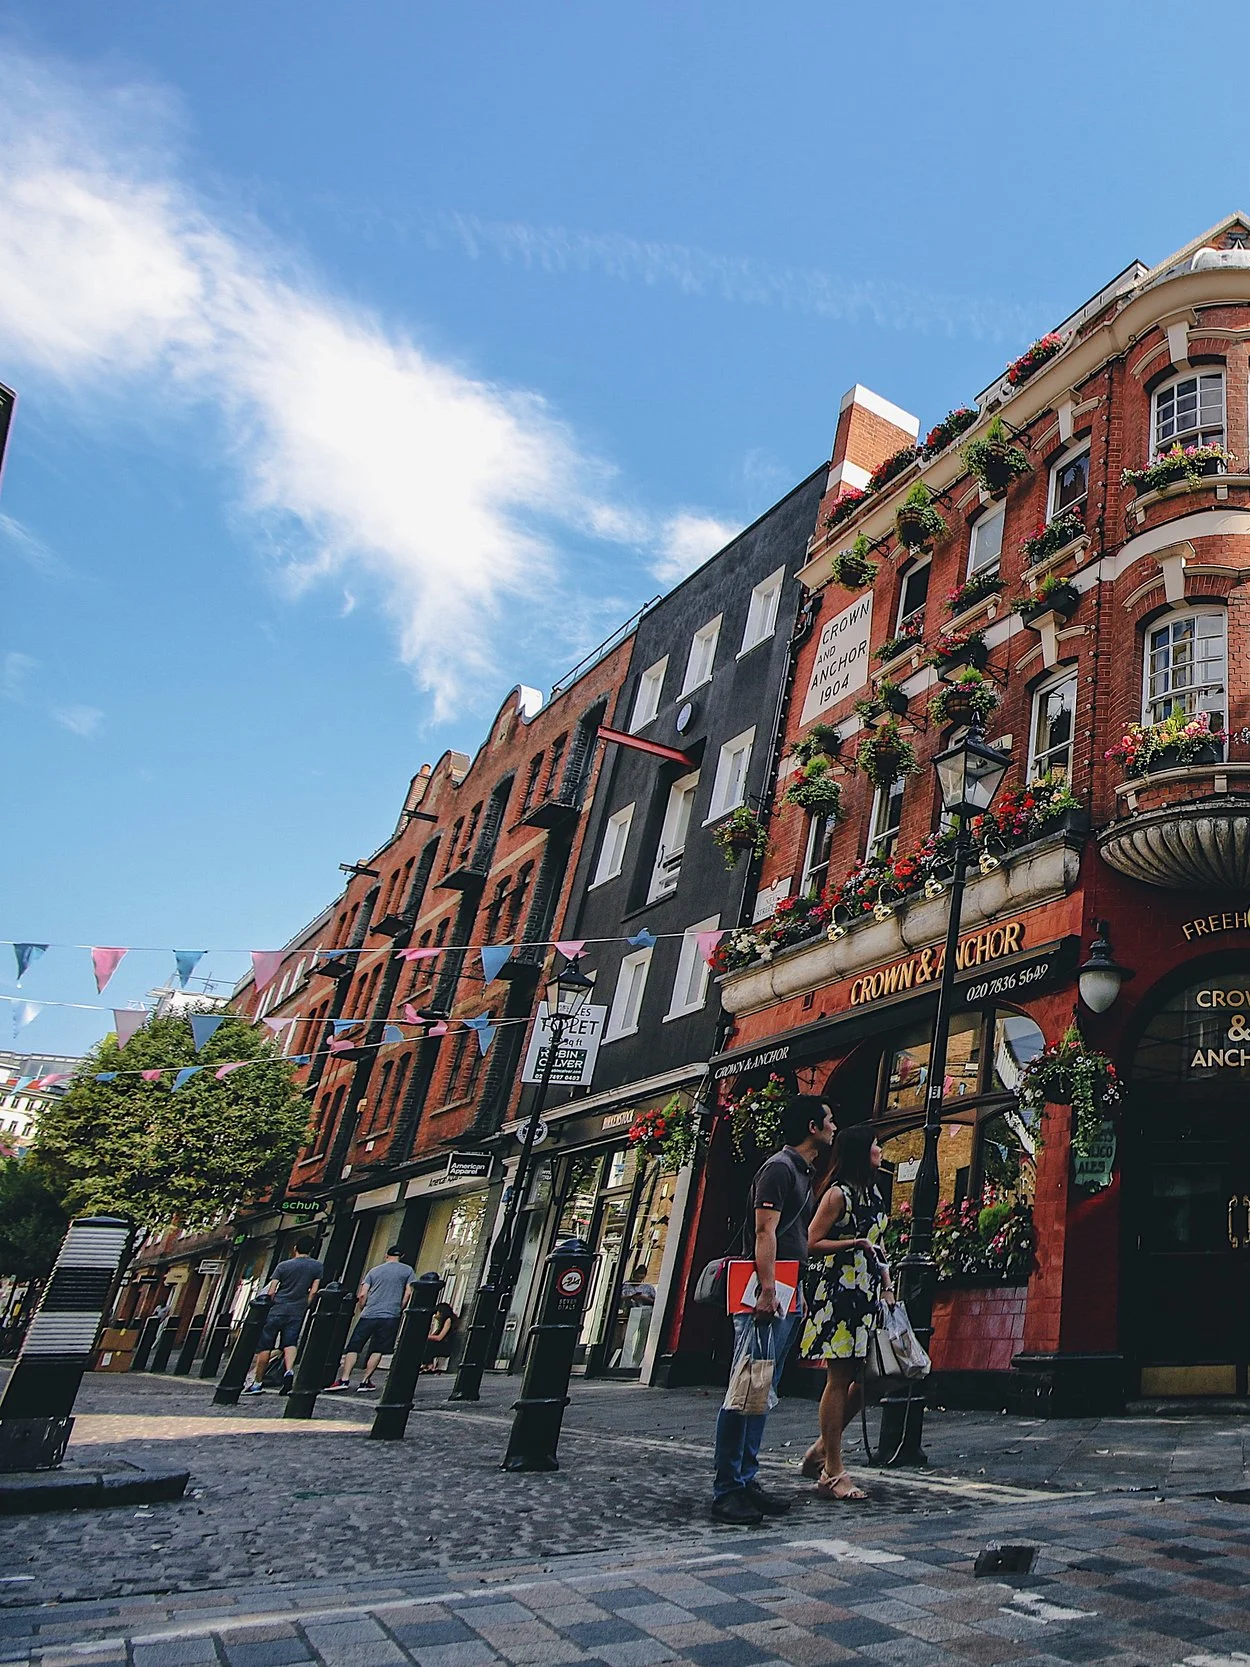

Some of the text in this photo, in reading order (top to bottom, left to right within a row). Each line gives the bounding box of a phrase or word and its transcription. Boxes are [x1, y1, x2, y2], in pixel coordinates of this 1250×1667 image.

[822, 600, 870, 645] CROWN
[811, 639, 867, 691] ANCHOR
[817, 645, 836, 666] AND
[819, 673, 850, 706] 1904
[851, 959, 915, 1006] CROWN
[915, 948, 933, 984] &
[966, 963, 1049, 1002] 020 7836 5649
[569, 1018, 600, 1035] LET
[538, 1058, 583, 1069] CLVER
[540, 1049, 578, 1059] RBIN
[714, 1046, 789, 1079] CROWN & ANCHOR
[451, 1162, 485, 1170] American
[281, 1200, 320, 1211] schuh
